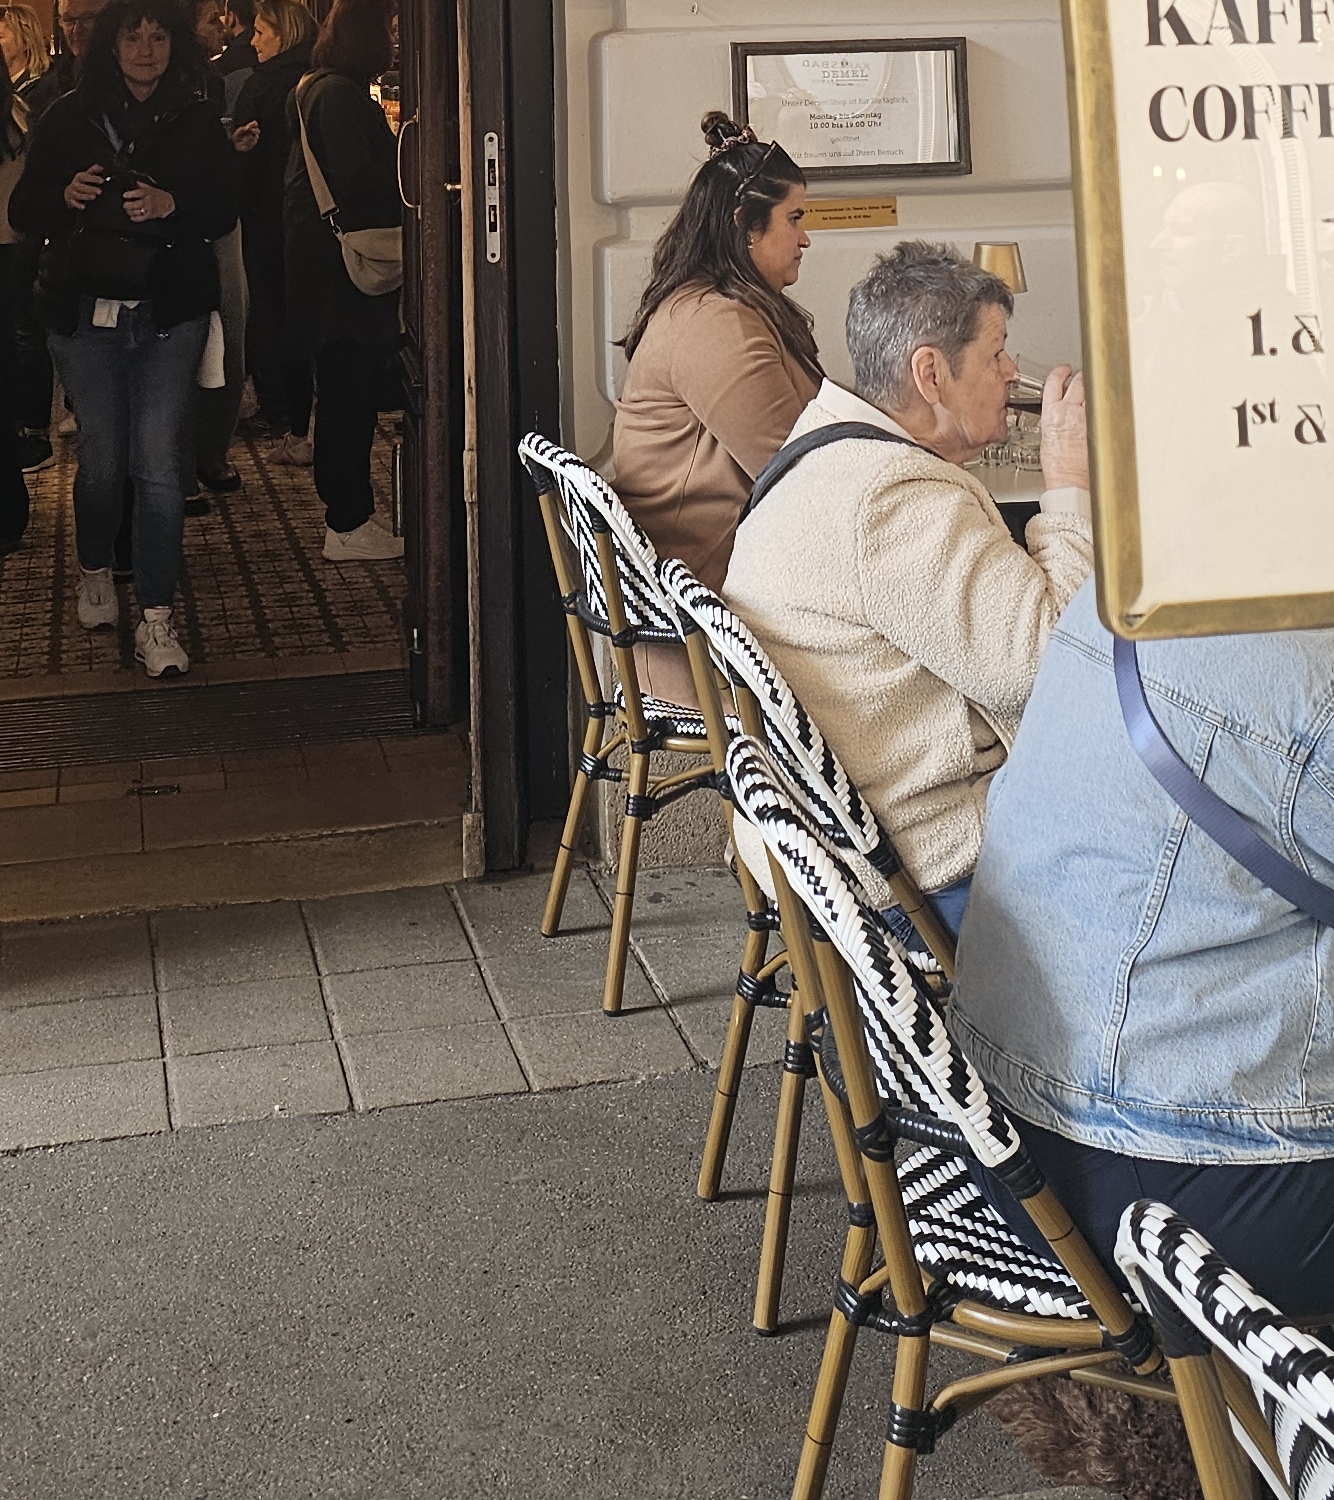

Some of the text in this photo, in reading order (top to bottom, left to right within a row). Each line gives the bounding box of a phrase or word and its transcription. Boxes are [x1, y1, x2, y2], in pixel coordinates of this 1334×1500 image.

[821, 69, 869, 79] DEMEL
[1246, 307, 1278, 357] 1.
[1291, 313, 1324, 355] &
[1231, 398, 1280, 448] 1st
[1293, 403, 1327, 445] &
